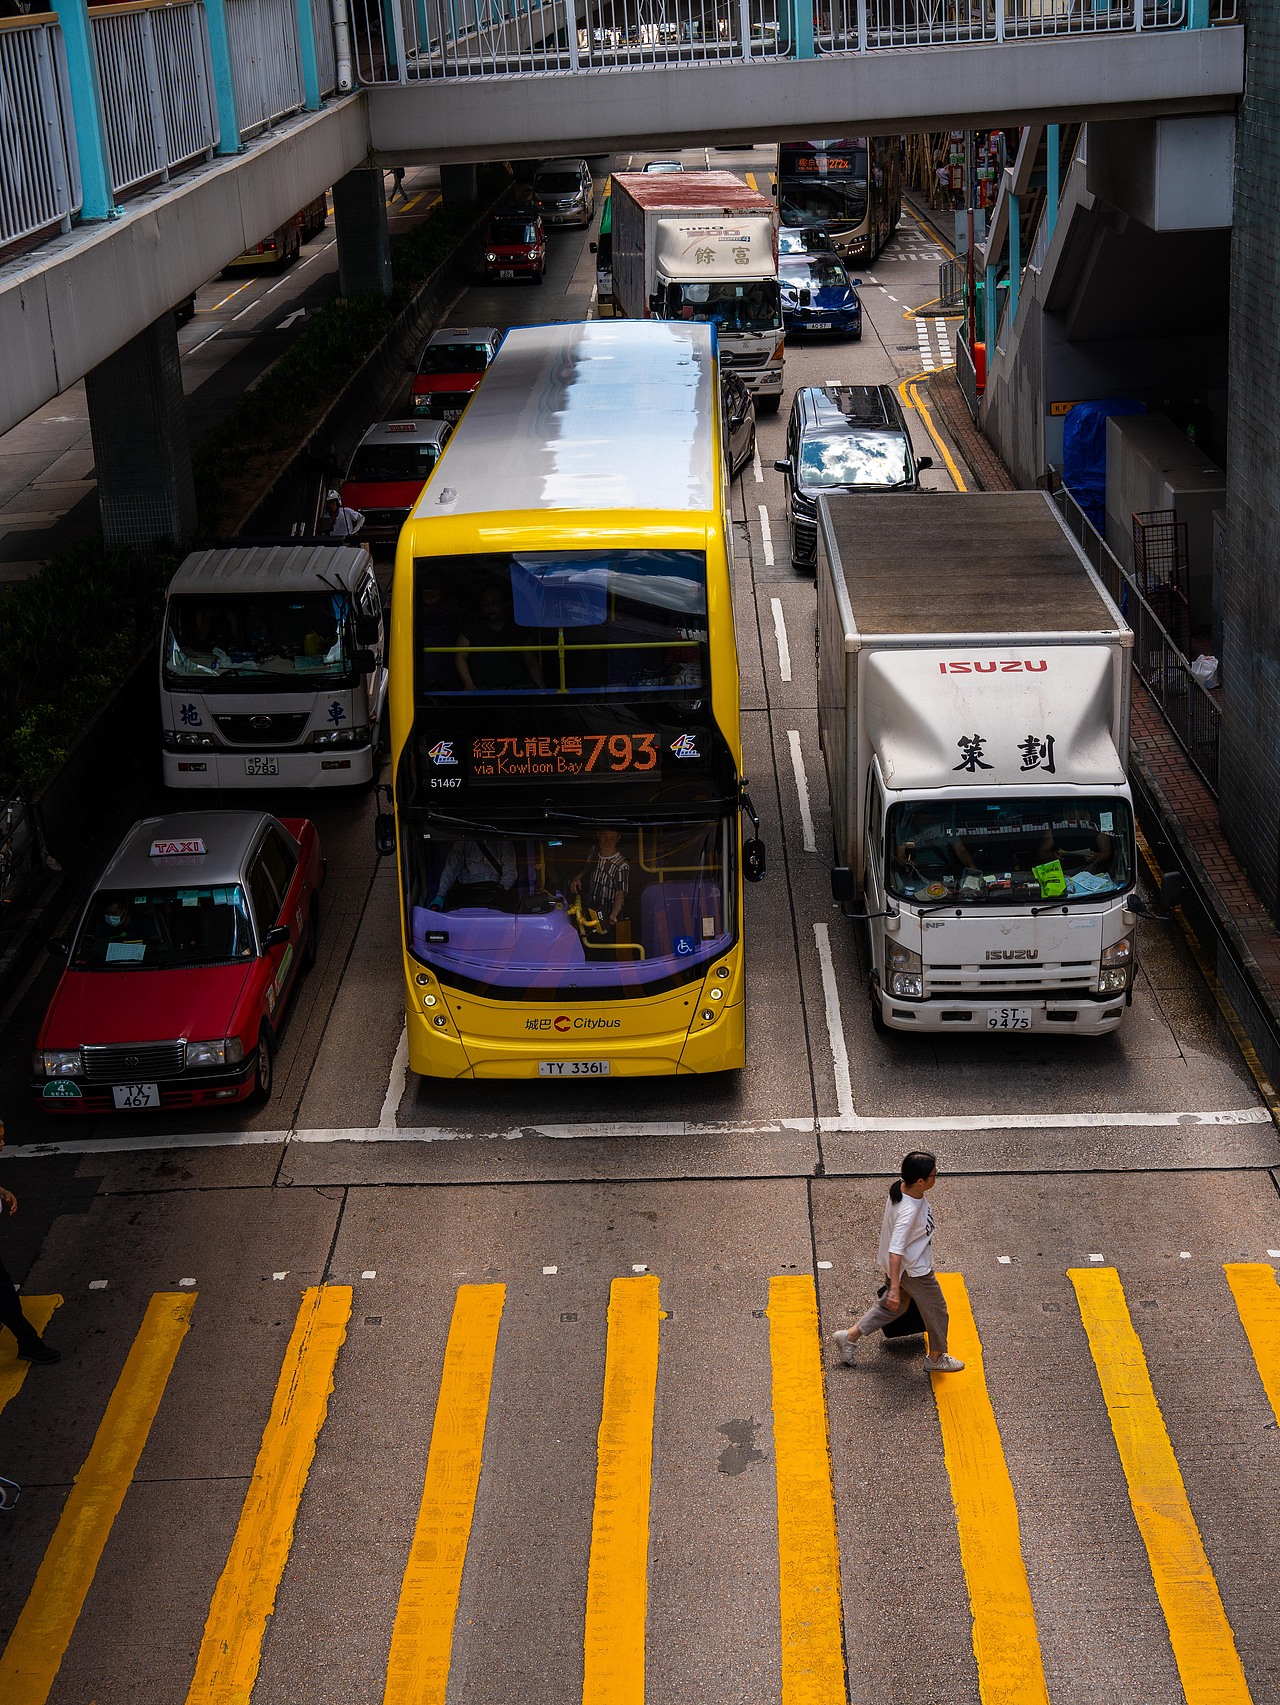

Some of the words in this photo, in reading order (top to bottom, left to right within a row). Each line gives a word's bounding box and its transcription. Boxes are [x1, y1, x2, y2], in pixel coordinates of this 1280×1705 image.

[939, 660, 1048, 674] ISUZU
[473, 736, 583, 759] 經九龍灣
[583, 733, 657, 772] 793
[952, 734, 1055, 774] 策劃
[254, 757, 269, 766] PJ
[473, 761, 495, 775] via
[497, 756, 554, 774] Kowloon
[557, 756, 583, 775] Bay
[247, 765, 276, 774] 9783
[430, 778, 462, 788] 51467
[155, 841, 199, 853] TAXI
[985, 949, 1039, 960] ISUZU
[1000, 1008, 1019, 1019] ST
[524, 1018, 552, 1031] 城巴
[573, 1017, 621, 1030] Citybus
[988, 1018, 1029, 1029] 9475
[546, 1063, 564, 1074] TY
[571, 1062, 603, 1074] 3361
[57, 1084, 65, 1092] 4
[125, 1085, 145, 1096] TX
[123, 1095, 150, 1107] 467
